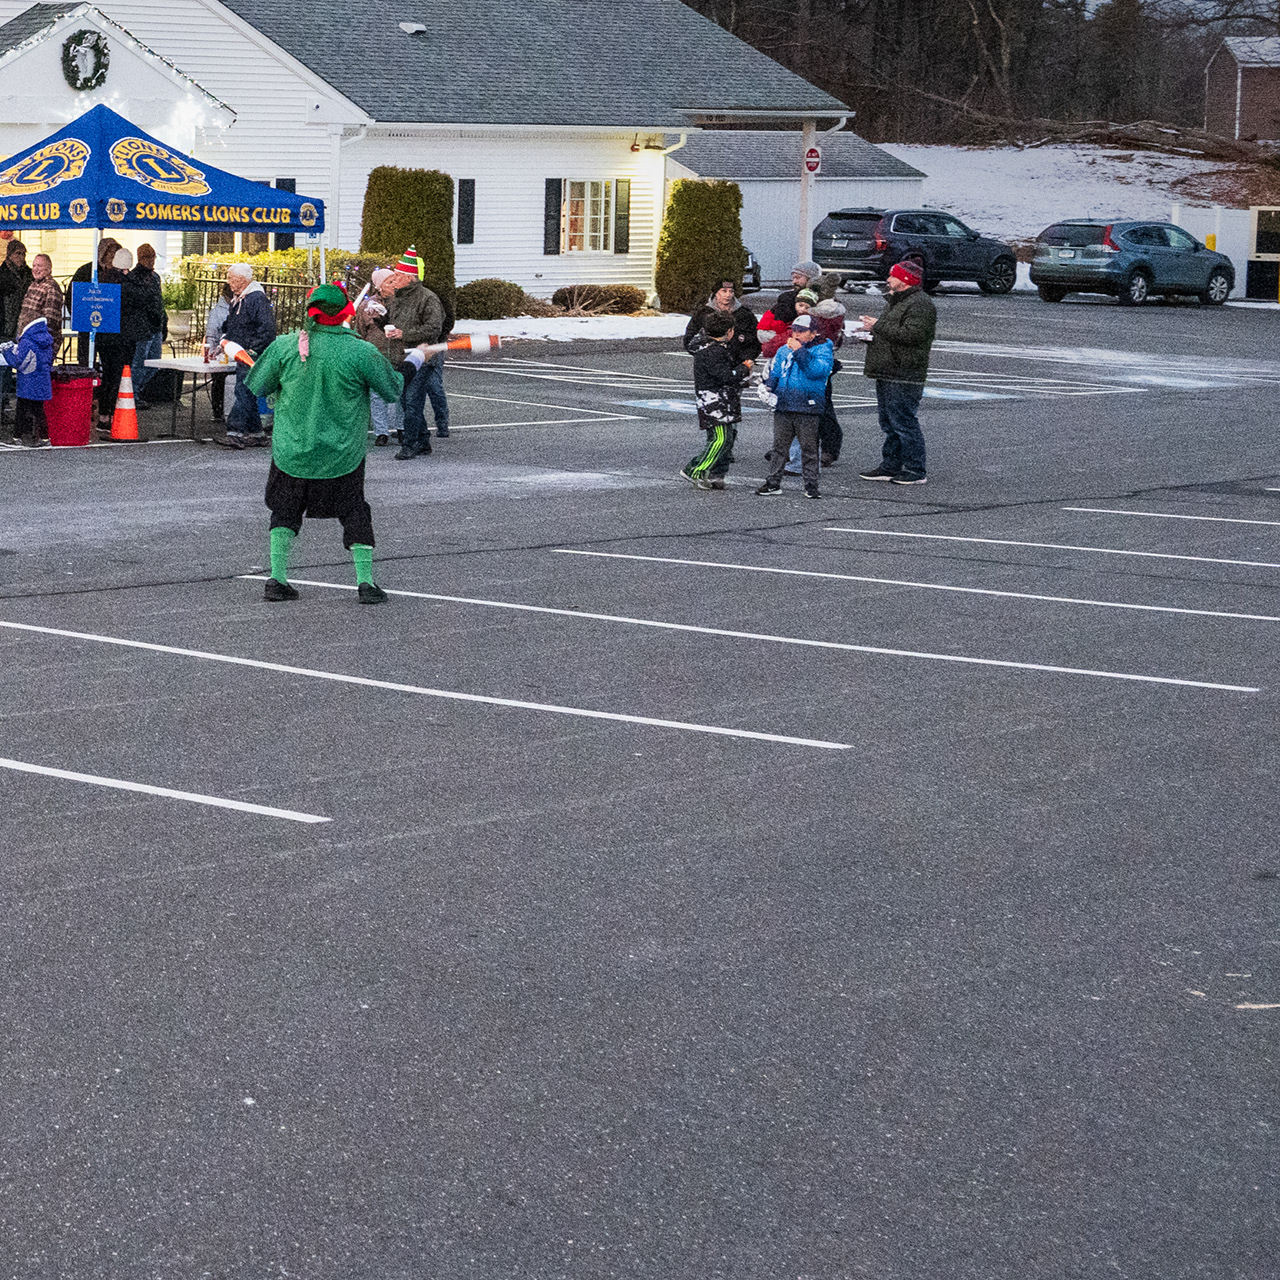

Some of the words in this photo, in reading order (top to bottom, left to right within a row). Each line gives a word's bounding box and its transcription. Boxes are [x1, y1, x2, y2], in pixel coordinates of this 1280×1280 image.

[38, 141, 85, 158] LIONS
[116, 140, 167, 157] LIONS
[20, 202, 61, 220] CLUB
[135, 202, 201, 222] SOMERS
[203, 205, 250, 223] LIONS
[251, 207, 292, 224] CLUB
